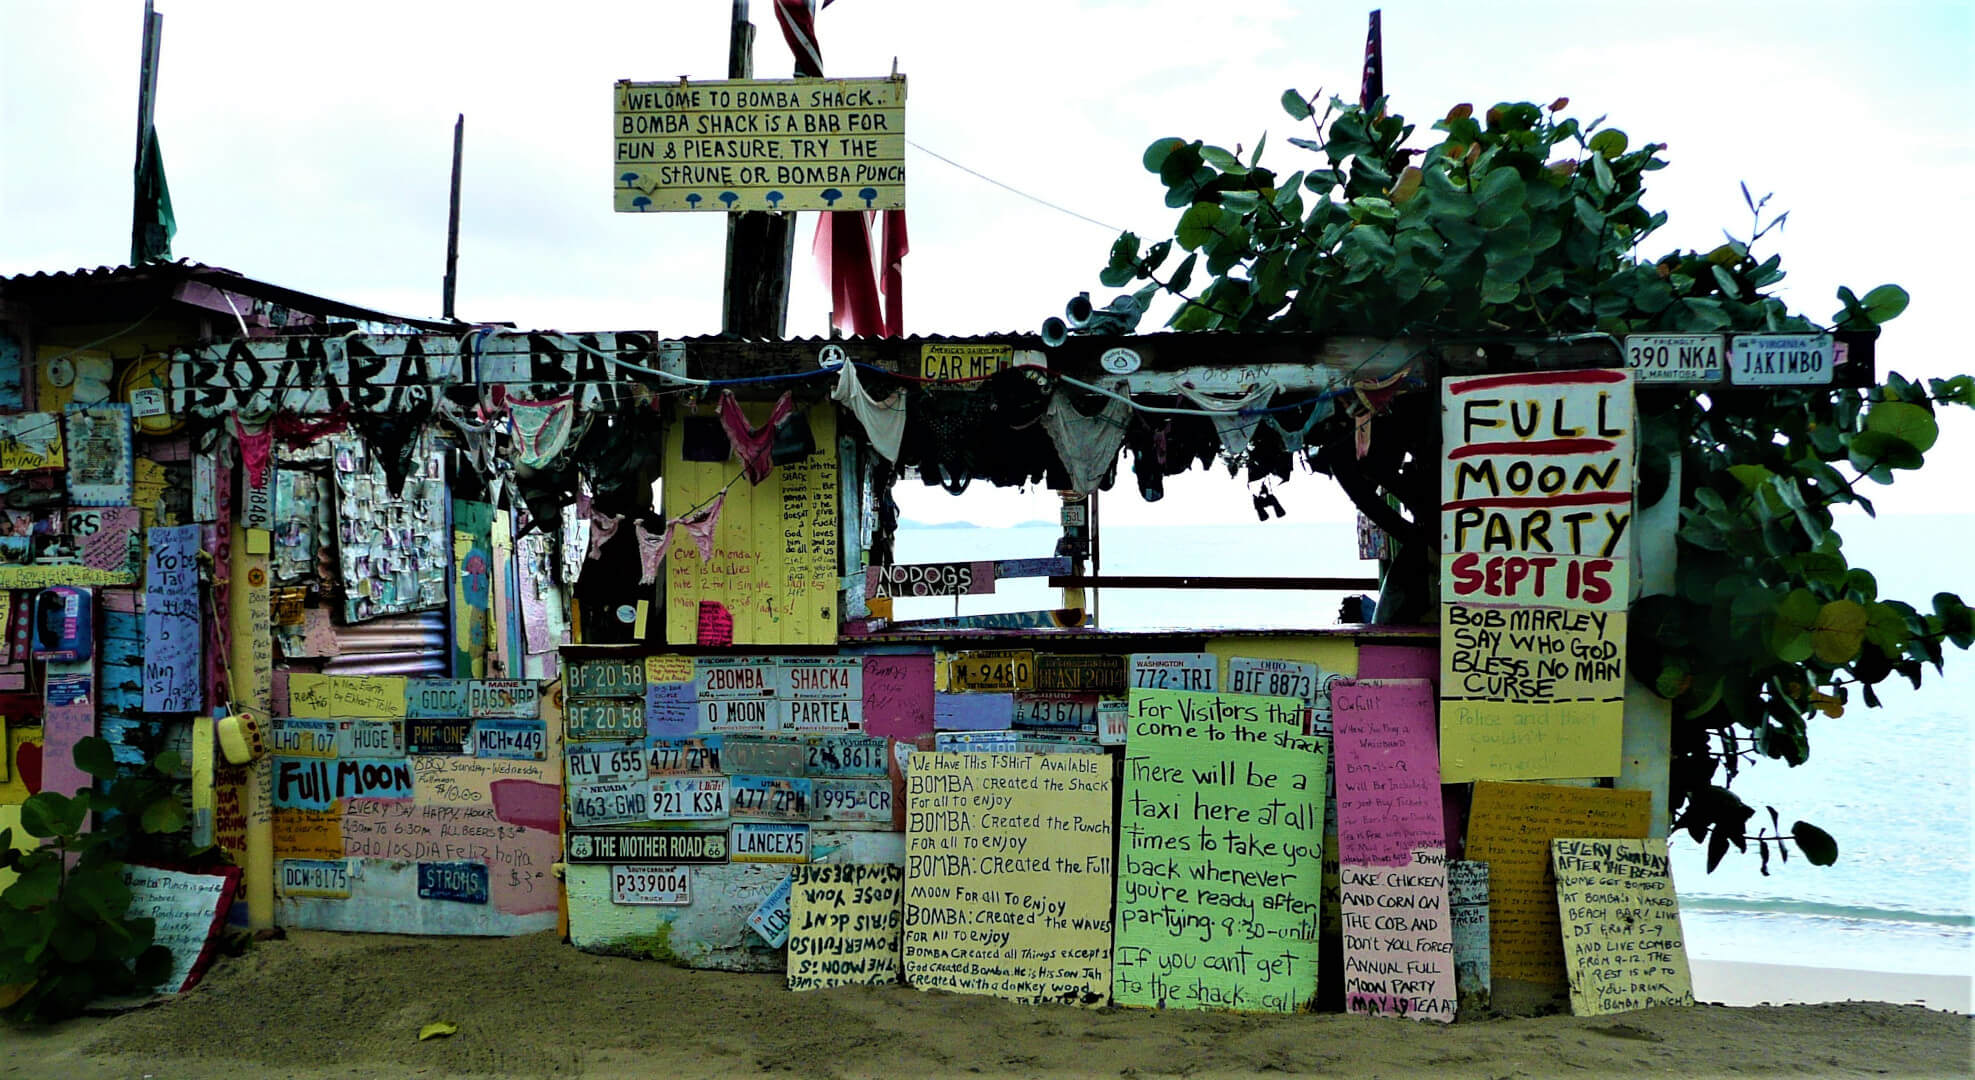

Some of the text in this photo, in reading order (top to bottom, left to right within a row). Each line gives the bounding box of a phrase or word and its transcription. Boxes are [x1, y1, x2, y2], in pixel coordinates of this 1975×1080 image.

[709, 91, 730, 109] TO
[737, 91, 800, 109] BOMBA
[622, 114, 689, 134] BOMBA
[696, 114, 758, 134] SHACK
[787, 114, 798, 132] A
[804, 113, 841, 133] BAR
[848, 113, 888, 132] FOR
[618, 141, 655, 161] FUN
[663, 142, 677, 160] &
[790, 138, 829, 158] TRY
[839, 138, 878, 158] THE
[740, 167, 766, 184] OR
[778, 165, 850, 185] BOMBA
[856, 164, 905, 182] PUNCH
[925, 355, 962, 379] CAR
[1629, 346, 1718, 368] 390 NKA
[1650, 369, 1697, 378] MANITOBA
[1463, 390, 1628, 444] FULL
[1454, 458, 1622, 501] MOON
[1454, 506, 1630, 558] PARTY
[1451, 552, 1614, 604] SEPT 15
[1449, 606, 1608, 640] BOB MARLEY
[1454, 628, 1618, 660] SAY WHO GOD
[1136, 660, 1184, 668] WASHINGTON
[1260, 660, 1287, 670] OHIO
[1452, 650, 1622, 683] BLESS NO MAN
[570, 664, 589, 687] BF
[596, 664, 616, 687] 20
[622, 664, 642, 687] 58
[707, 668, 763, 690] 2BOMBA
[791, 668, 849, 689] SHACK4
[1234, 670, 1310, 697] BIF 8873
[1463, 673, 1557, 698] CURSE
[570, 707, 642, 729] BF 20 58
[727, 702, 766, 722] MOON
[792, 702, 850, 723] PARTEA
[1032, 702, 1083, 721] 43 671
[1138, 696, 1305, 727] For Visitors that
[354, 730, 389, 749] HUGE
[479, 730, 541, 750] MCH 449
[675, 739, 694, 747] UTAH
[838, 738, 884, 748] Wyoming
[1136, 722, 1325, 755] come to the shack
[570, 751, 642, 775] RLV 655
[650, 750, 679, 770] 477
[843, 747, 869, 768] 861
[279, 760, 412, 802] Full MOON
[761, 780, 781, 788] UTAH
[1126, 757, 1307, 790] There will be a
[590, 784, 627, 793] NEVADA
[735, 788, 765, 809] 477
[653, 792, 723, 813] 921 KSA
[815, 790, 890, 811] 1995 CR
[1129, 789, 1314, 830] taxi here at all
[343, 836, 381, 855] Todo
[594, 836, 616, 857] THE
[619, 836, 668, 857] MOTHER
[670, 836, 702, 857] ROAD
[738, 833, 804, 854] LANCEX5
[1557, 841, 1612, 859] EVERY
[1056, 857, 1082, 873] the
[1086, 856, 1110, 875] Full
[1558, 856, 1629, 875] AFTER THE
[617, 875, 687, 892] P339004
[1341, 869, 1445, 889] CAKE CHICKEN
[1342, 893, 1440, 910] AND CORN ON
[1342, 912, 1408, 931] THE COB
[1576, 940, 1682, 955] AND LIVE COMBO
[822, 959, 866, 974] MOON
[868, 958, 896, 972] THE
